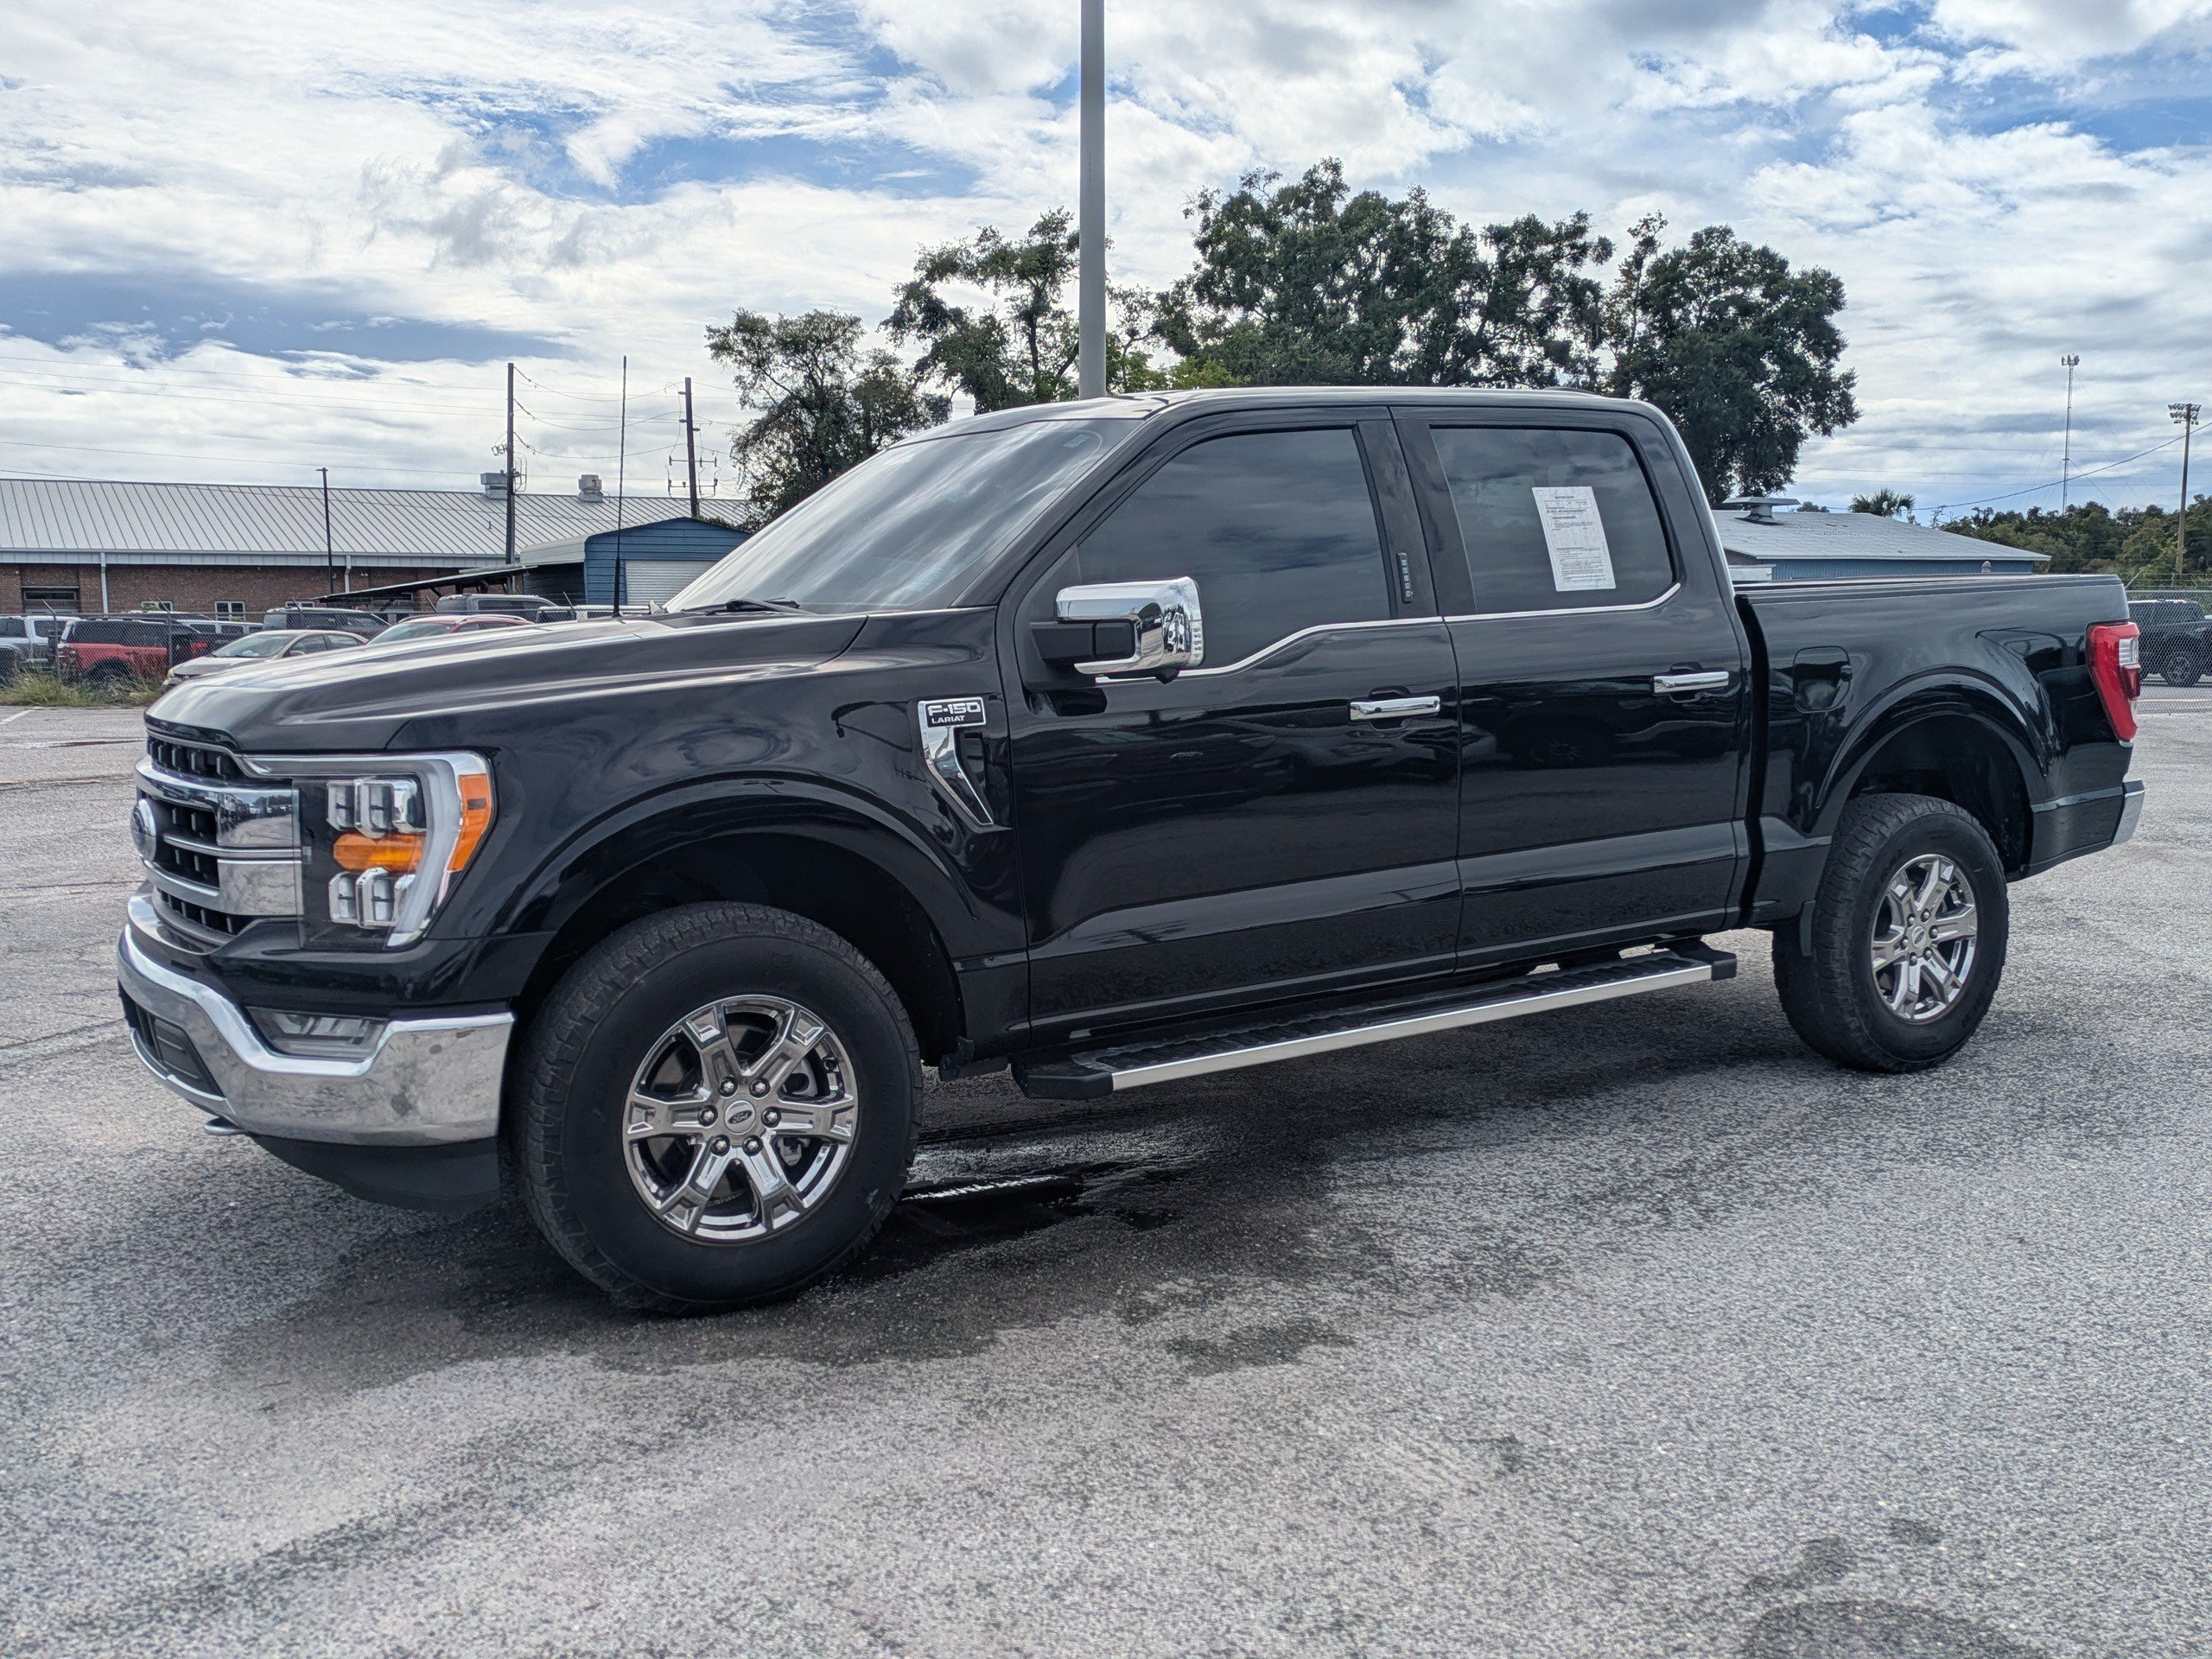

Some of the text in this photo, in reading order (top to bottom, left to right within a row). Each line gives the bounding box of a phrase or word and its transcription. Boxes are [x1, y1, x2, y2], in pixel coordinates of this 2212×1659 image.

[928, 702, 982, 716] F-150
[931, 715, 966, 724] LARIAT
[731, 1111, 750, 1124] Ford
